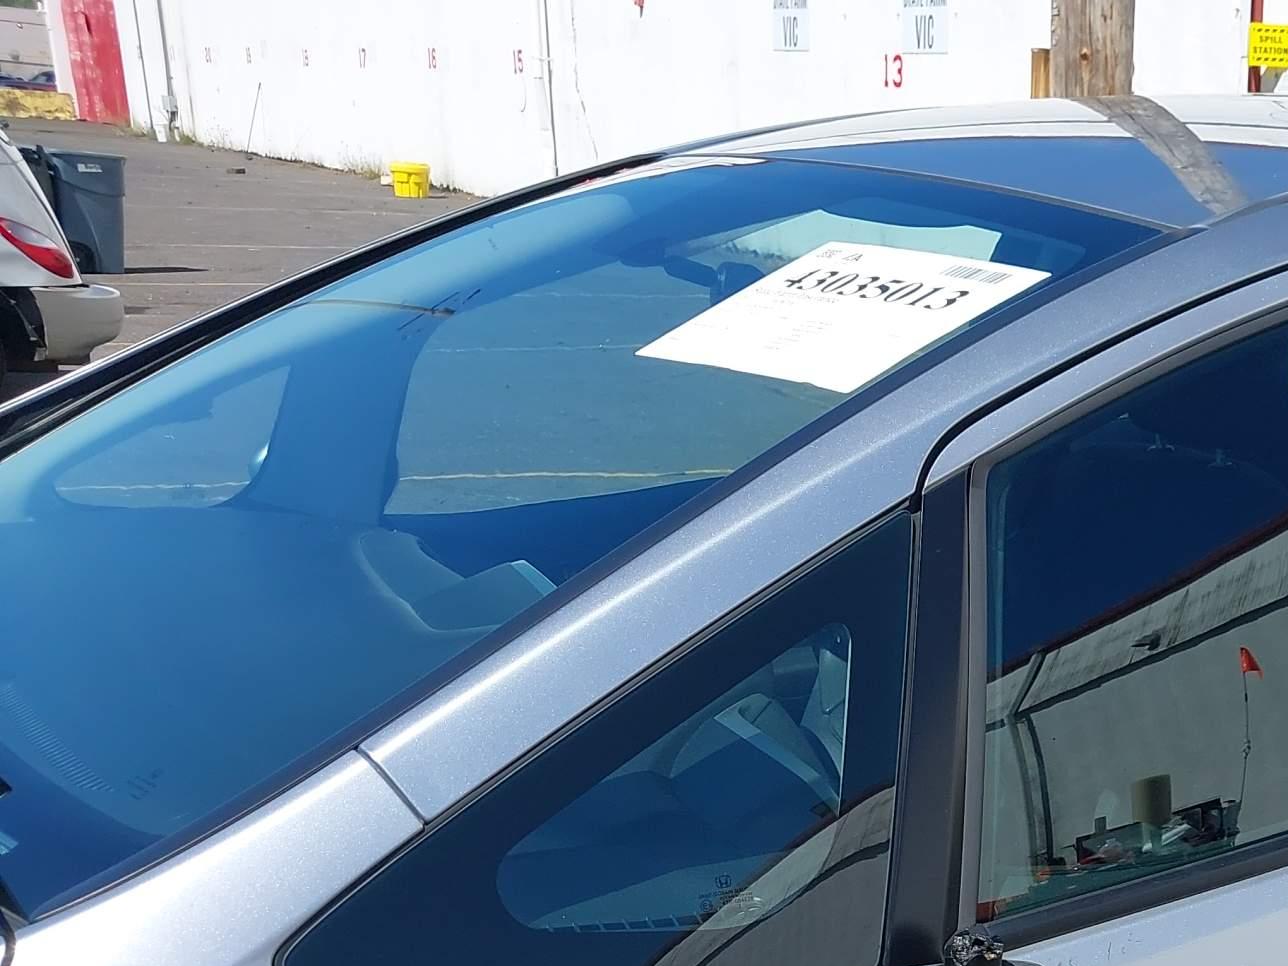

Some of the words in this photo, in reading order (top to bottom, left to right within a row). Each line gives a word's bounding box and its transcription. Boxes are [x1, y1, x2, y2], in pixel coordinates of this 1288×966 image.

[783, 16, 798, 47] VIC
[915, 15, 934, 49] VIC
[1259, 35, 1283, 44] SPILL
[358, 47, 366, 68] 17
[427, 47, 437, 69] 16
[512, 49, 524, 74] 15
[1253, 46, 1288, 55] STATION
[884, 54, 903, 88] 13
[784, 269, 970, 310] 43035013
